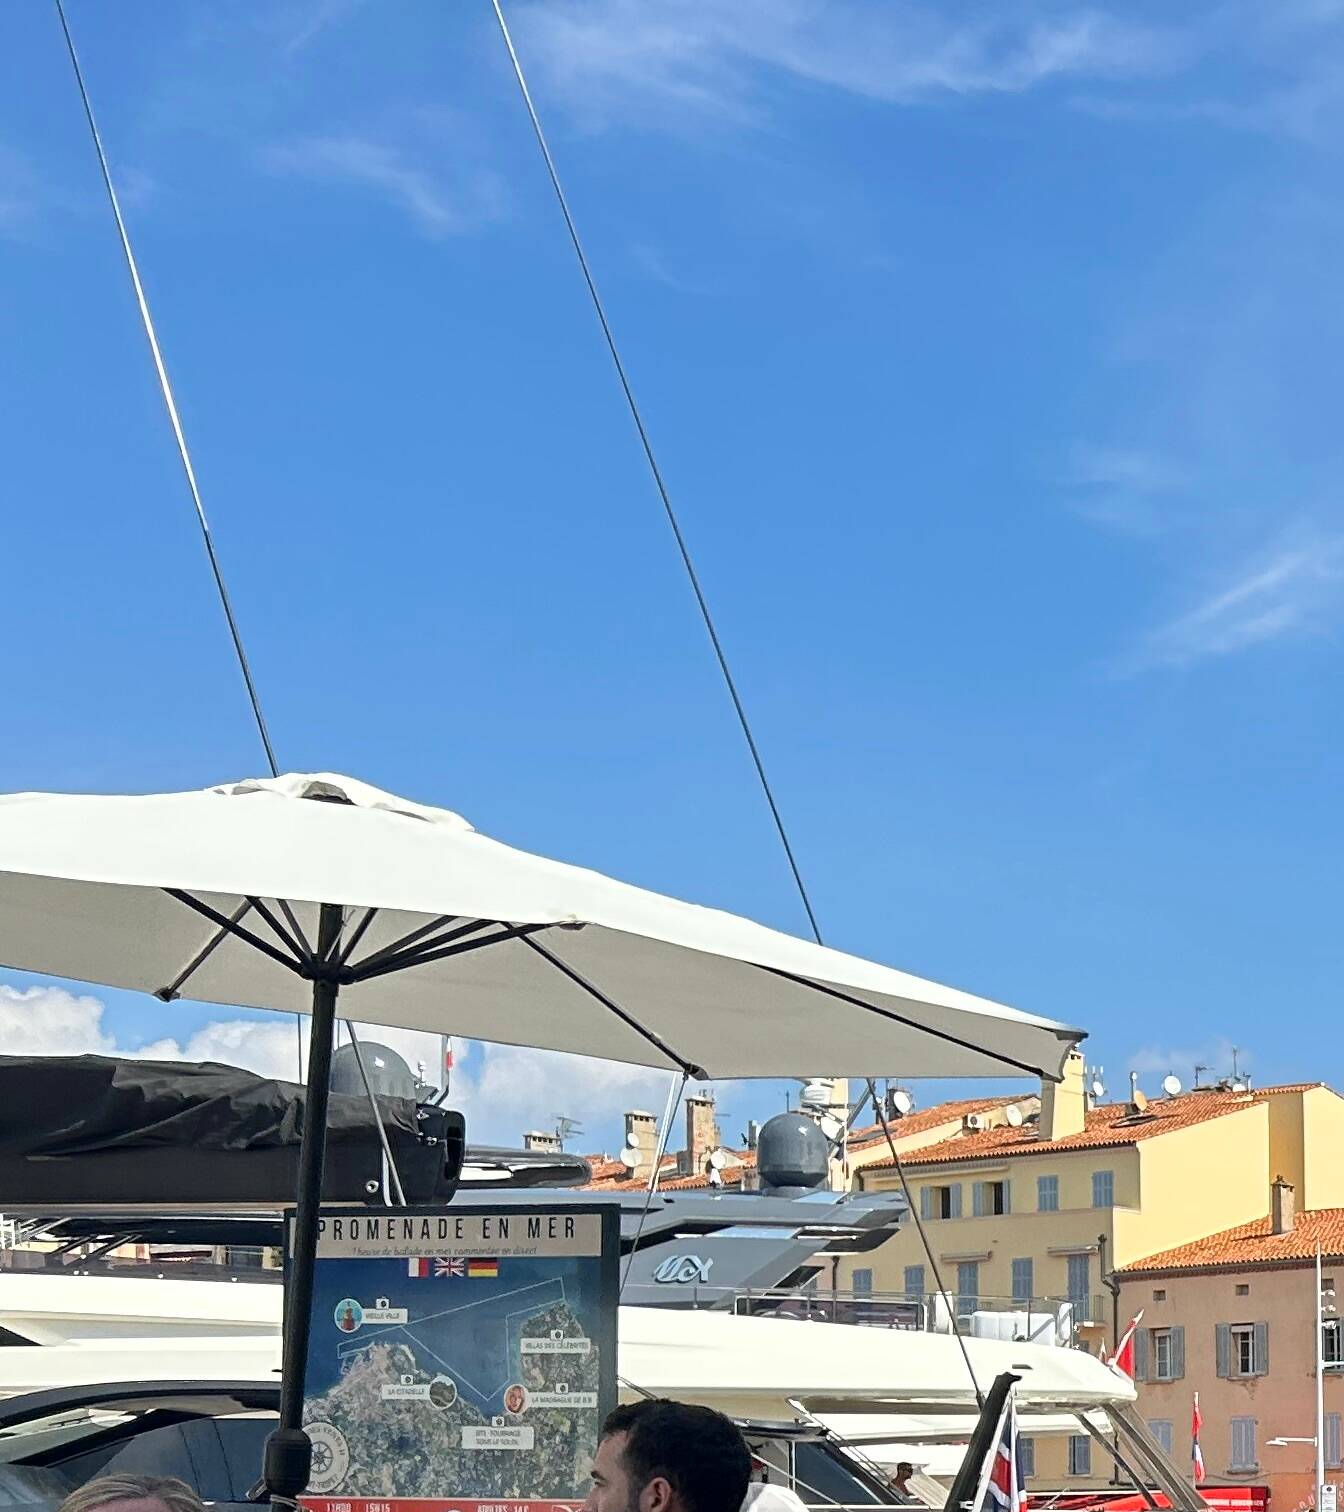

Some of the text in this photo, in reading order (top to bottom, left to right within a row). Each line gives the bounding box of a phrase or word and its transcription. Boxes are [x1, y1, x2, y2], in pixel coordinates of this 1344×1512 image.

[318, 1216, 575, 1241] PROMENADE EN MER
